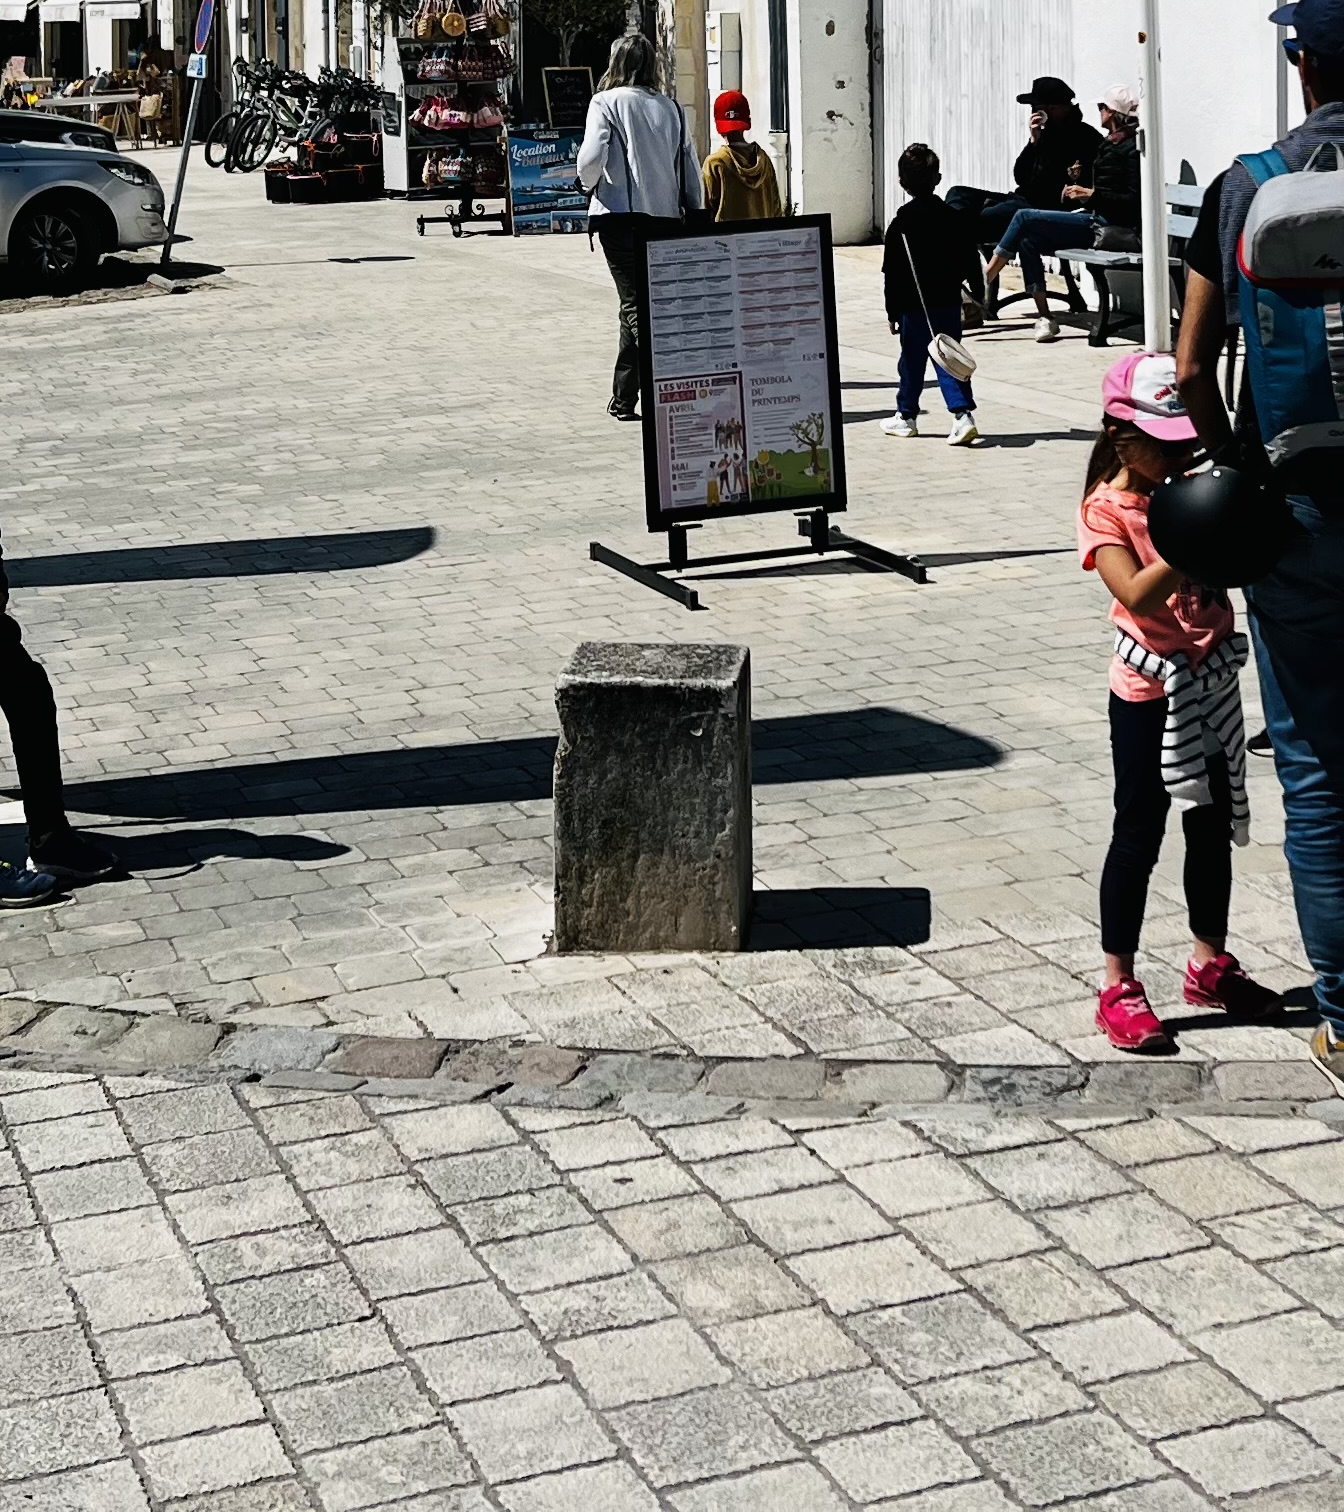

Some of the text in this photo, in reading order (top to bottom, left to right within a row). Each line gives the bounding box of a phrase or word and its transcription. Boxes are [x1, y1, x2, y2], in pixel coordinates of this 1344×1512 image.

[510, 143, 556, 161] Location
[658, 378, 710, 393] LES VISITES
[749, 375, 793, 387] TOMBOLA
[660, 391, 695, 403] FLASH
[751, 387, 764, 397] DU
[751, 394, 801, 407] PRINTEMPS
[669, 403, 696, 414] AVRIL
